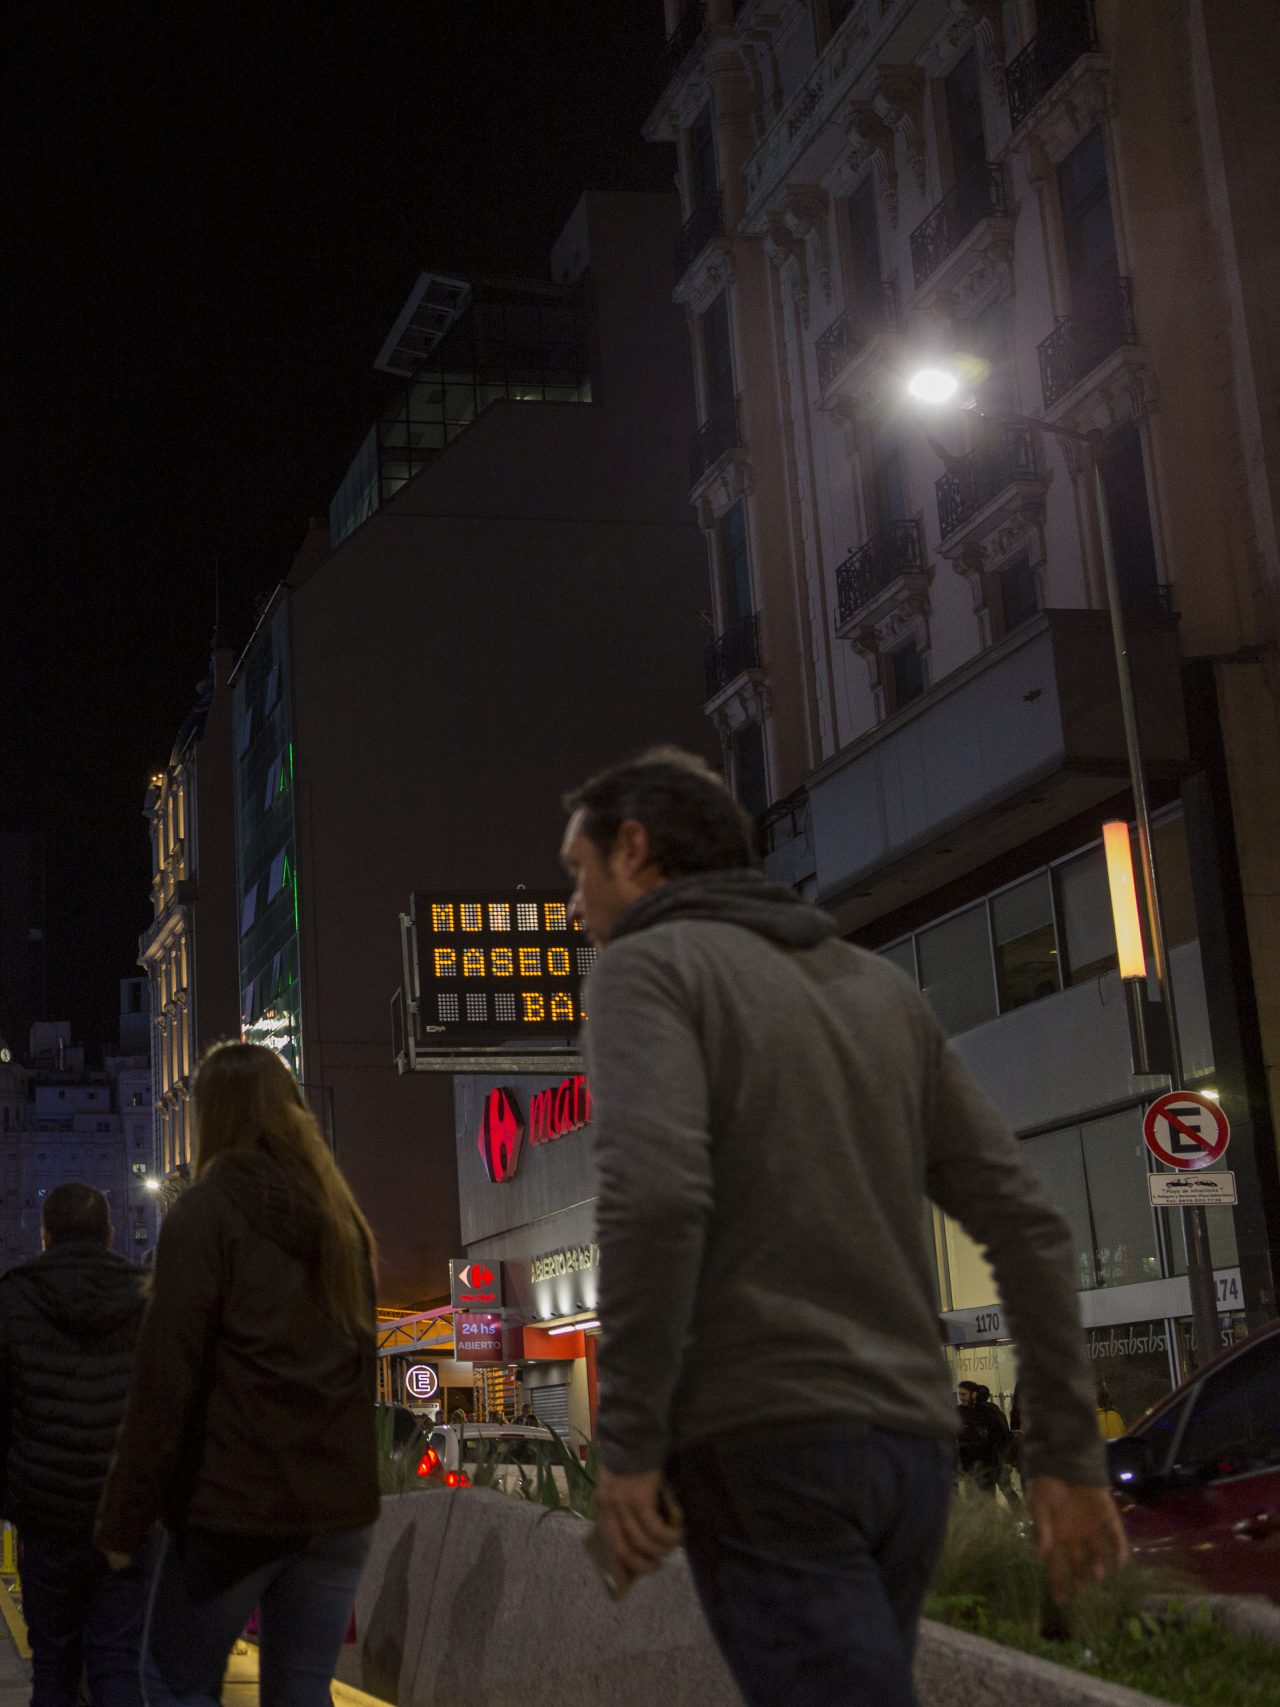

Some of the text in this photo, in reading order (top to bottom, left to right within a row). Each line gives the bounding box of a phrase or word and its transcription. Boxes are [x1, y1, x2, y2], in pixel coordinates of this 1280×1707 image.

[434, 948, 571, 977] PASEO
[522, 992, 590, 1022] BA
[1167, 1107, 1208, 1153] E
[531, 1252, 567, 1283] ABIERTO
[462, 1322, 496, 1335] 24 hs
[975, 1312, 1000, 1333] 1170
[458, 1341, 501, 1350] ABIERTO
[413, 1371, 431, 1392] E
